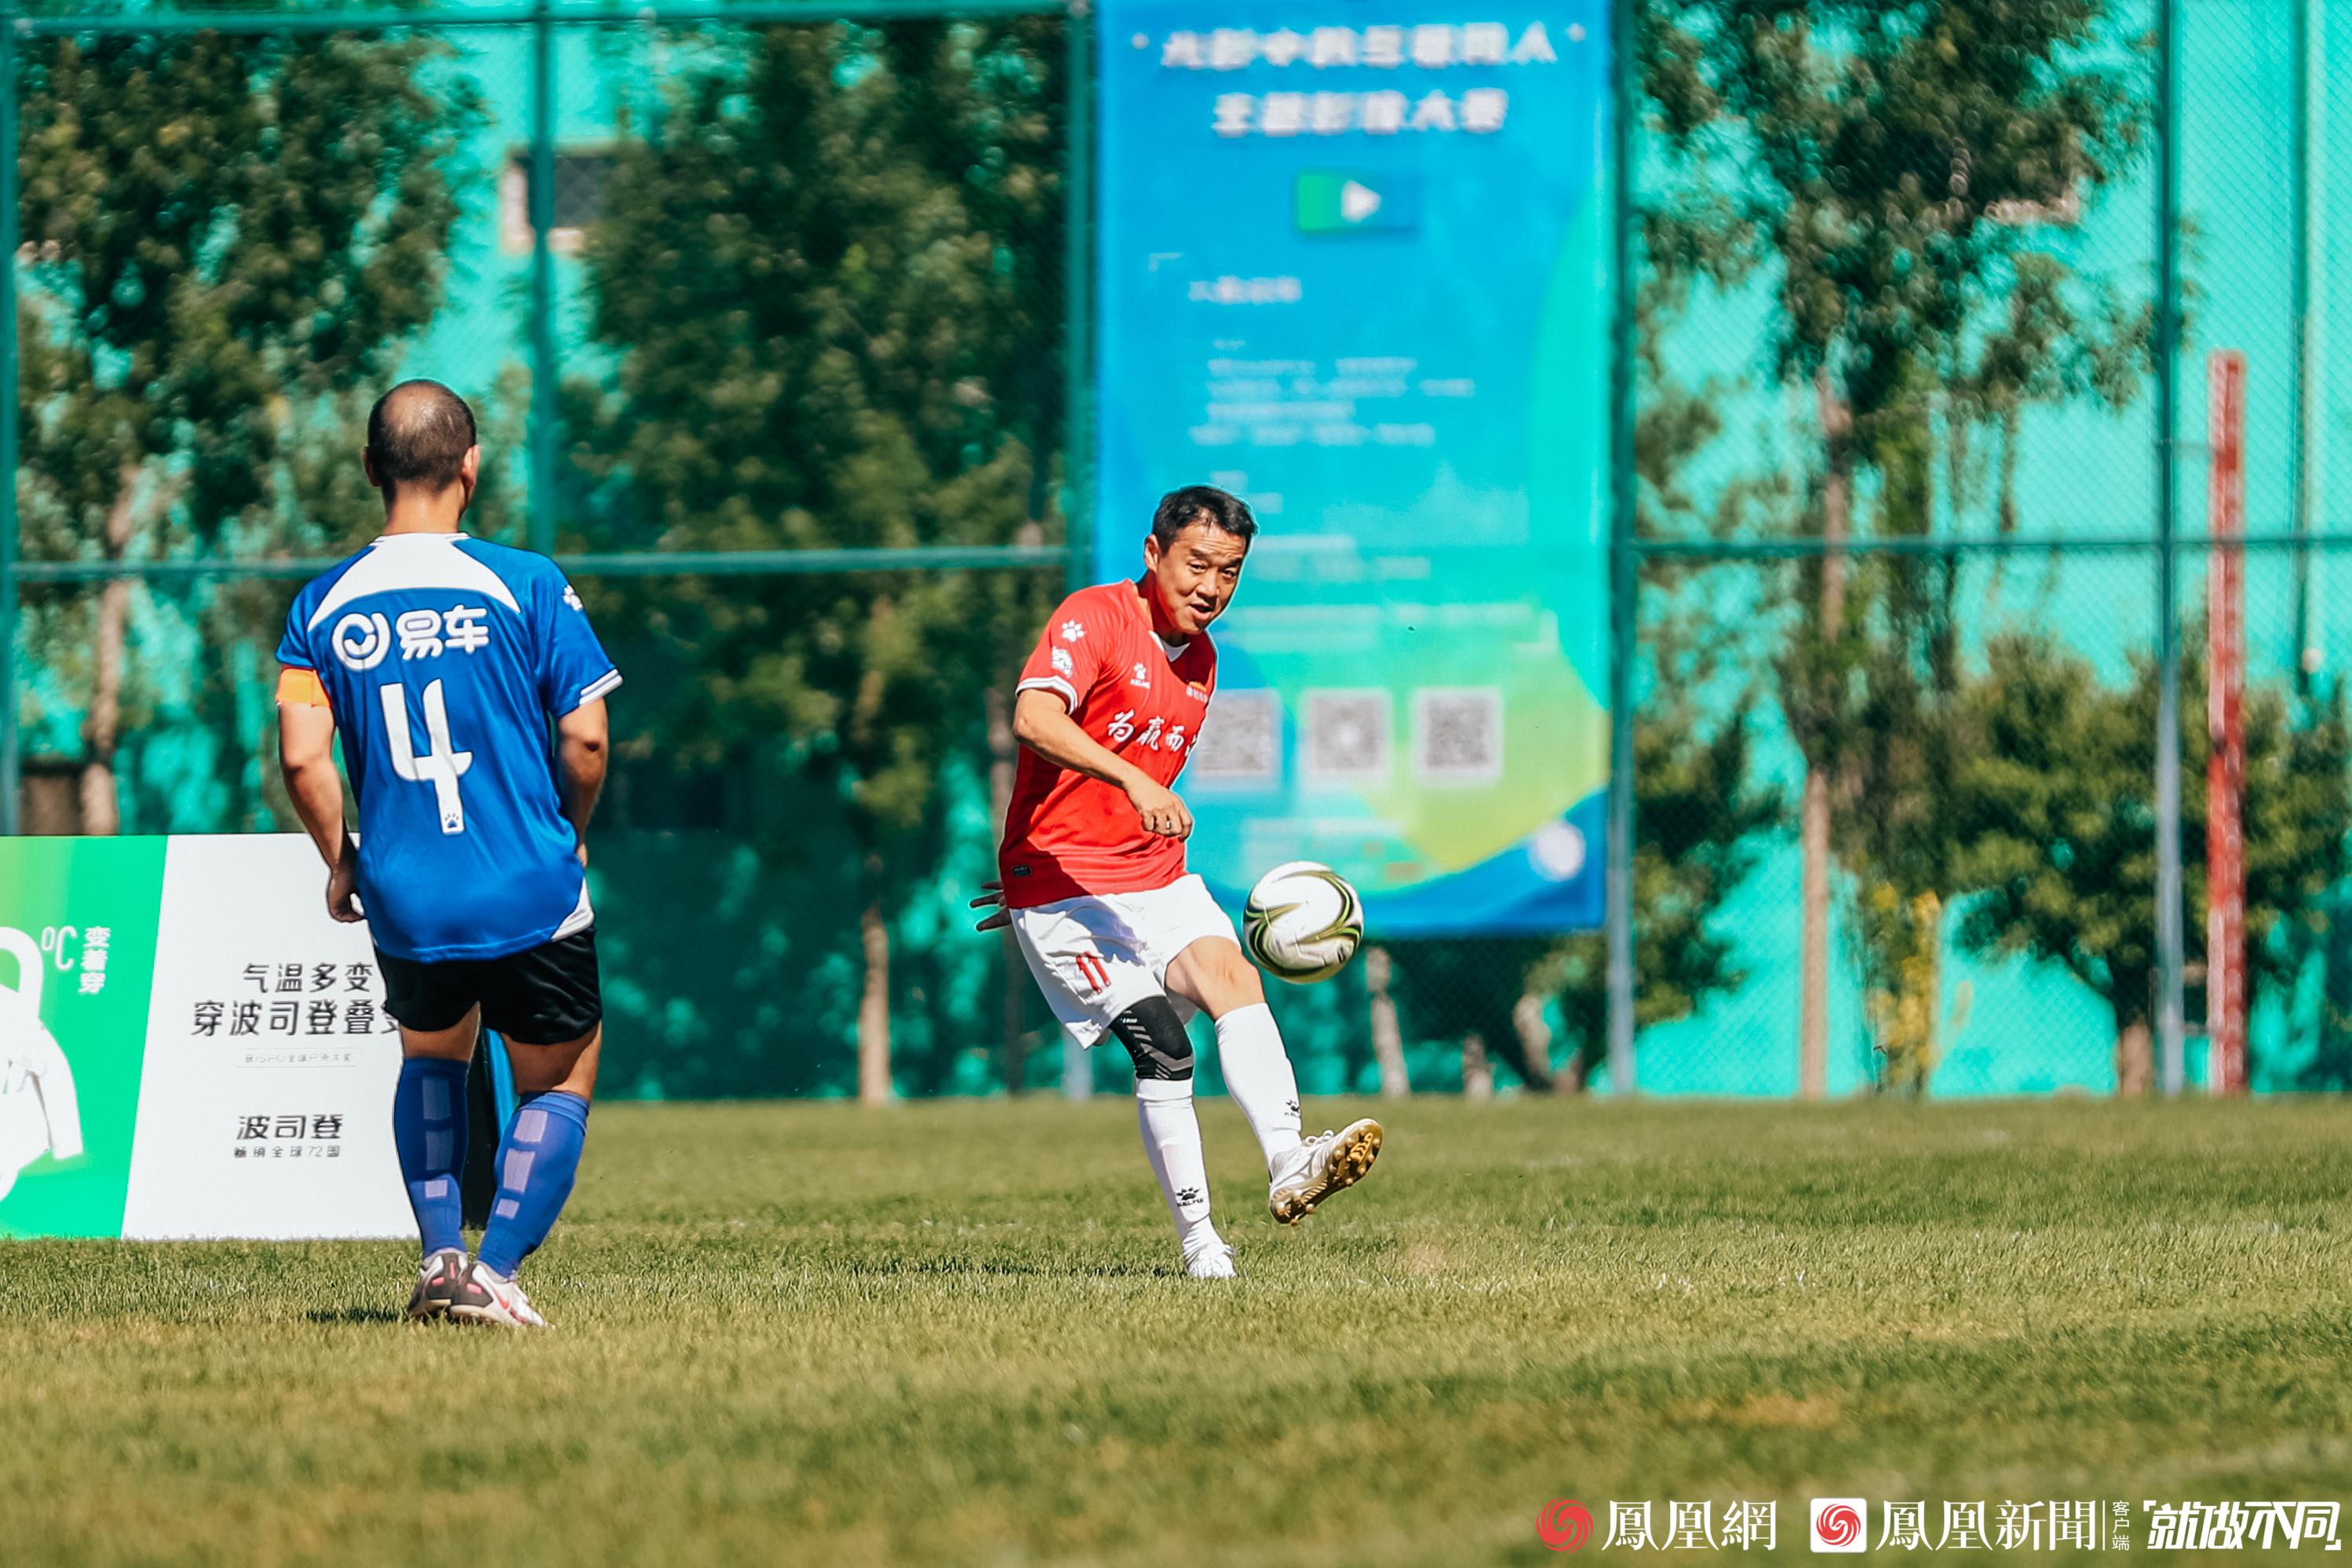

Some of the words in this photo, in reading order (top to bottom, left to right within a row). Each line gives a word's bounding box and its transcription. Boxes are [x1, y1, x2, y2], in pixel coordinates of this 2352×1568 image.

[396, 603, 490, 662] 易车
[380, 678, 473, 835] 4
[1107, 708, 1197, 757] 为赢而
[78, 925, 111, 994] 变着穿
[242, 962, 374, 994] 气温多变
[1075, 950, 1111, 994] 11
[236, 1114, 344, 1140] 波司登
